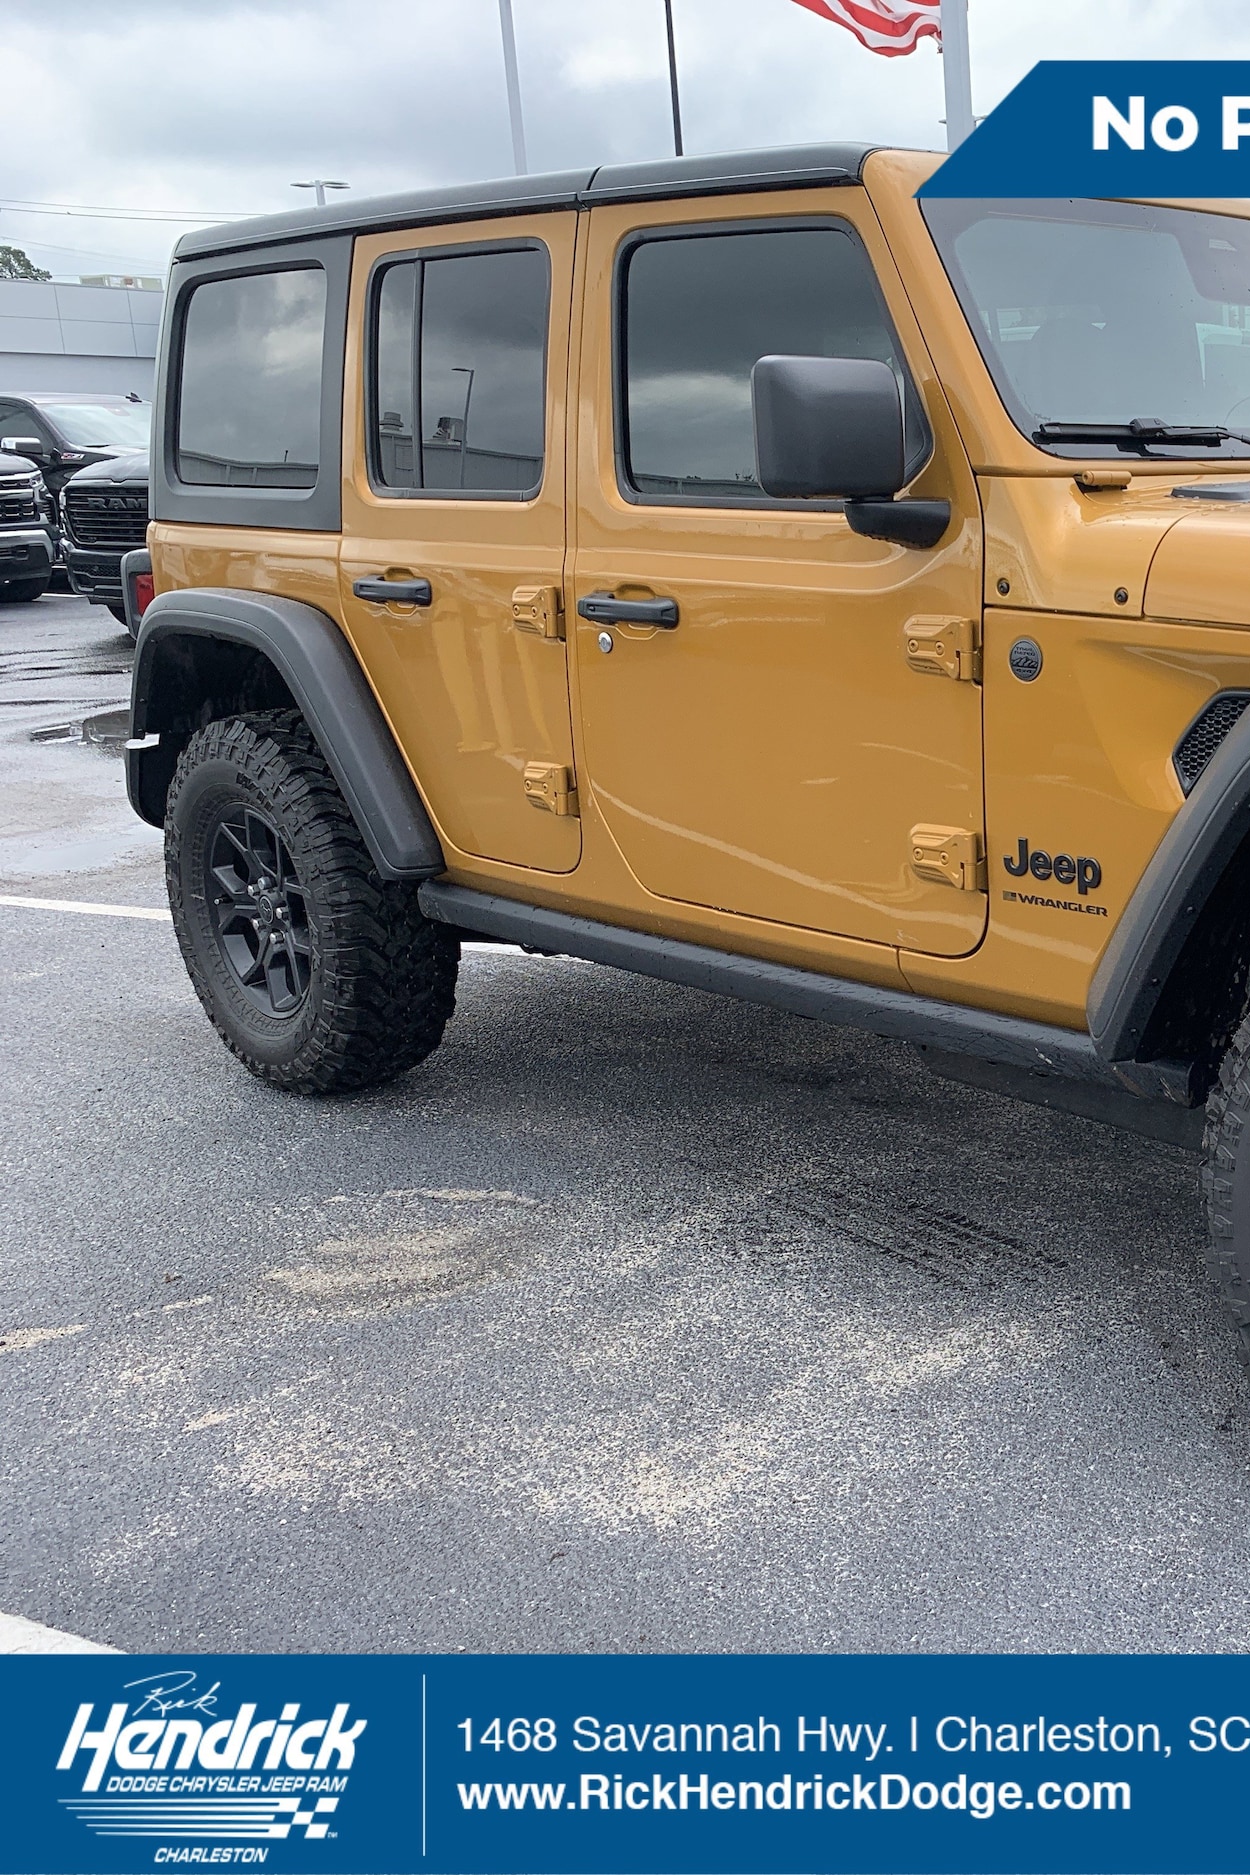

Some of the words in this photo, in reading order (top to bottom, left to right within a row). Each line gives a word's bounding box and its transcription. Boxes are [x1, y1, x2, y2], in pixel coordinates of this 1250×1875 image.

[87, 497, 148, 509] RAM
[1003, 837, 1102, 896] Jeep
[1017, 893, 1108, 917] WRANGLER
